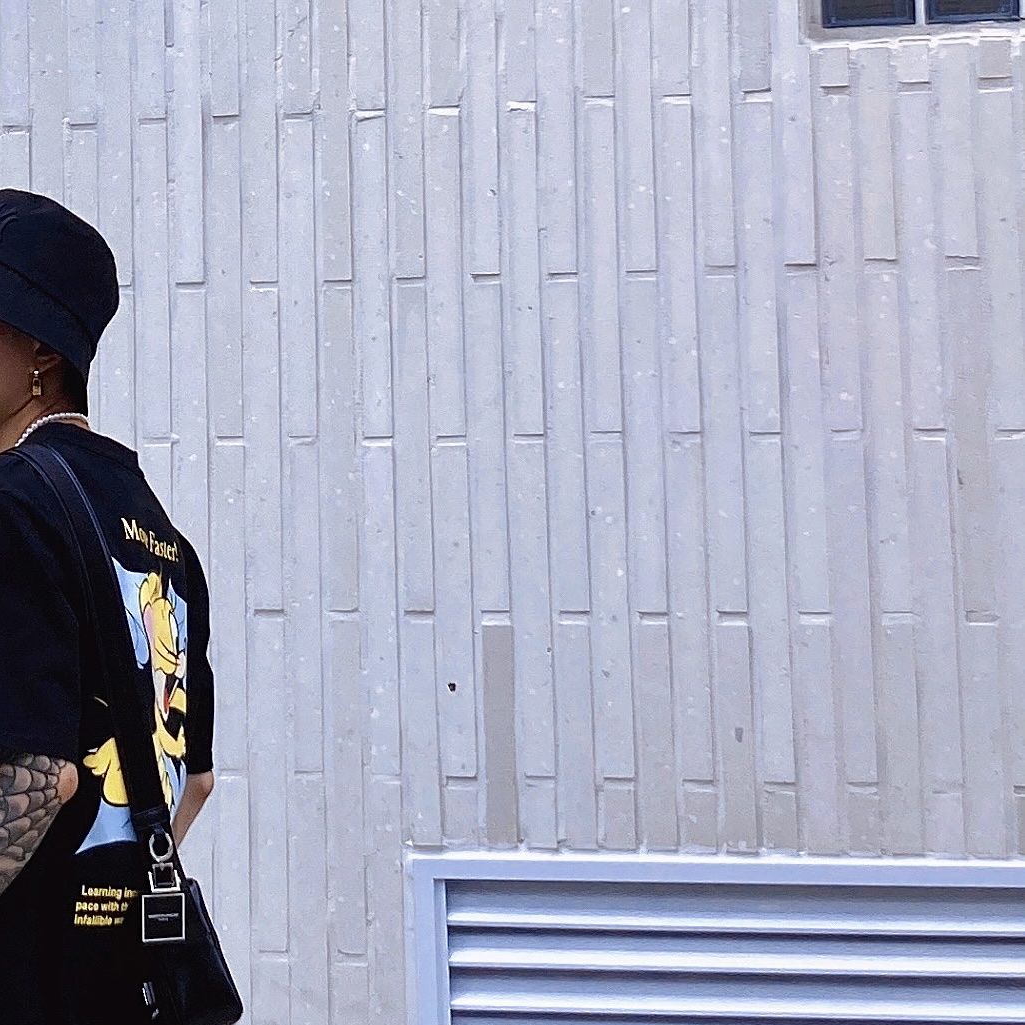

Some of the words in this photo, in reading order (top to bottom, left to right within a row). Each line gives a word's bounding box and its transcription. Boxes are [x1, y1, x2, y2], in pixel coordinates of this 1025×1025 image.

[81, 885, 123, 900] Learning
[75, 901, 100, 912] pace
[100, 900, 120, 912] with
